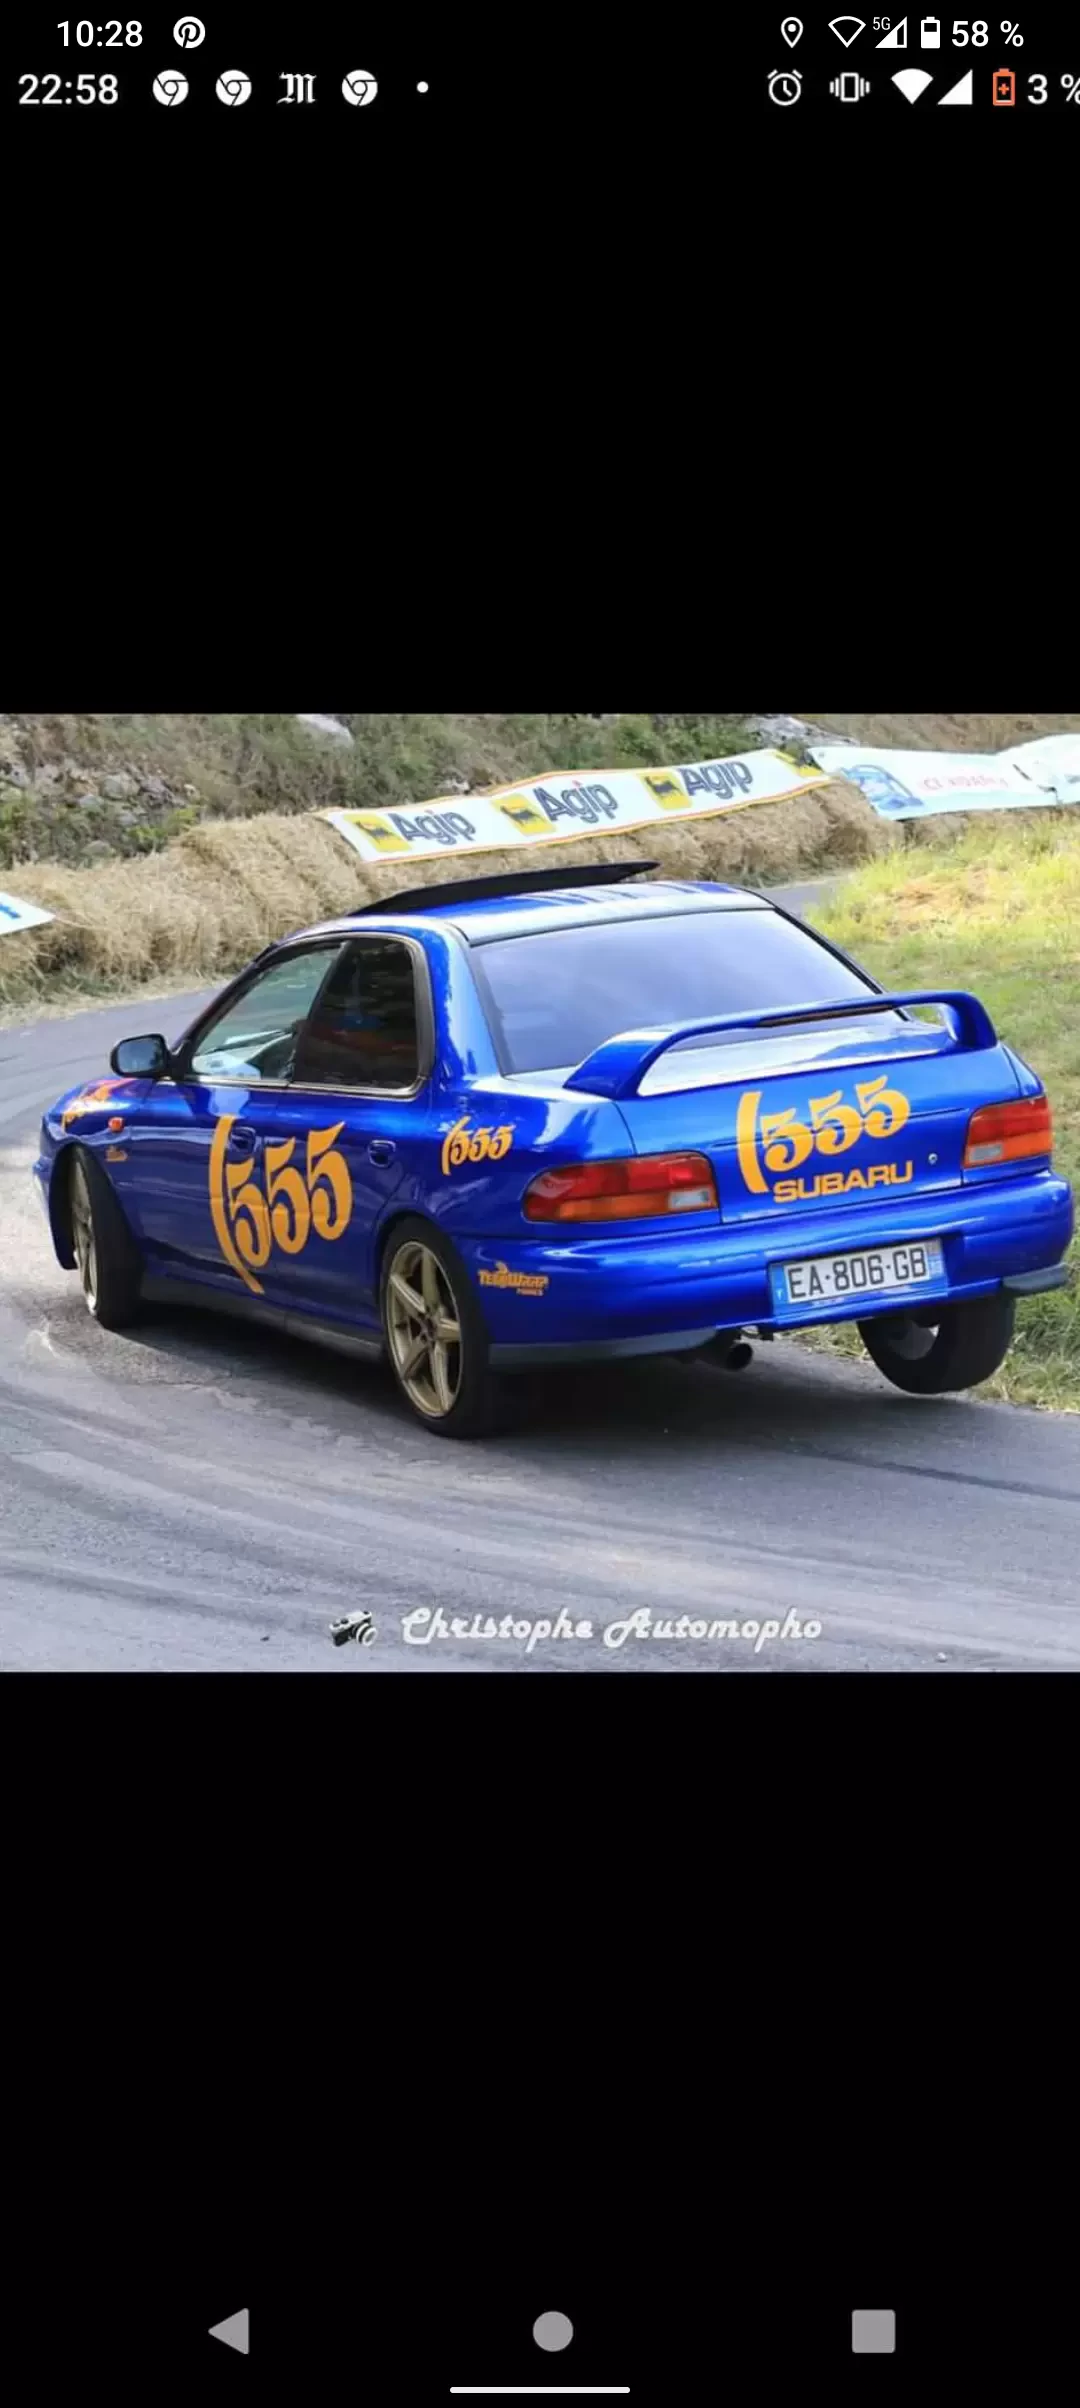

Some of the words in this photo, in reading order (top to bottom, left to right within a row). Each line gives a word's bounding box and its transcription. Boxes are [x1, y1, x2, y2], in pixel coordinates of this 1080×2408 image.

[387, 809, 477, 846] Agip
[533, 780, 619, 824] Agip
[677, 760, 754, 800] Agip
[773, 1161, 913, 1203] SUBARU
